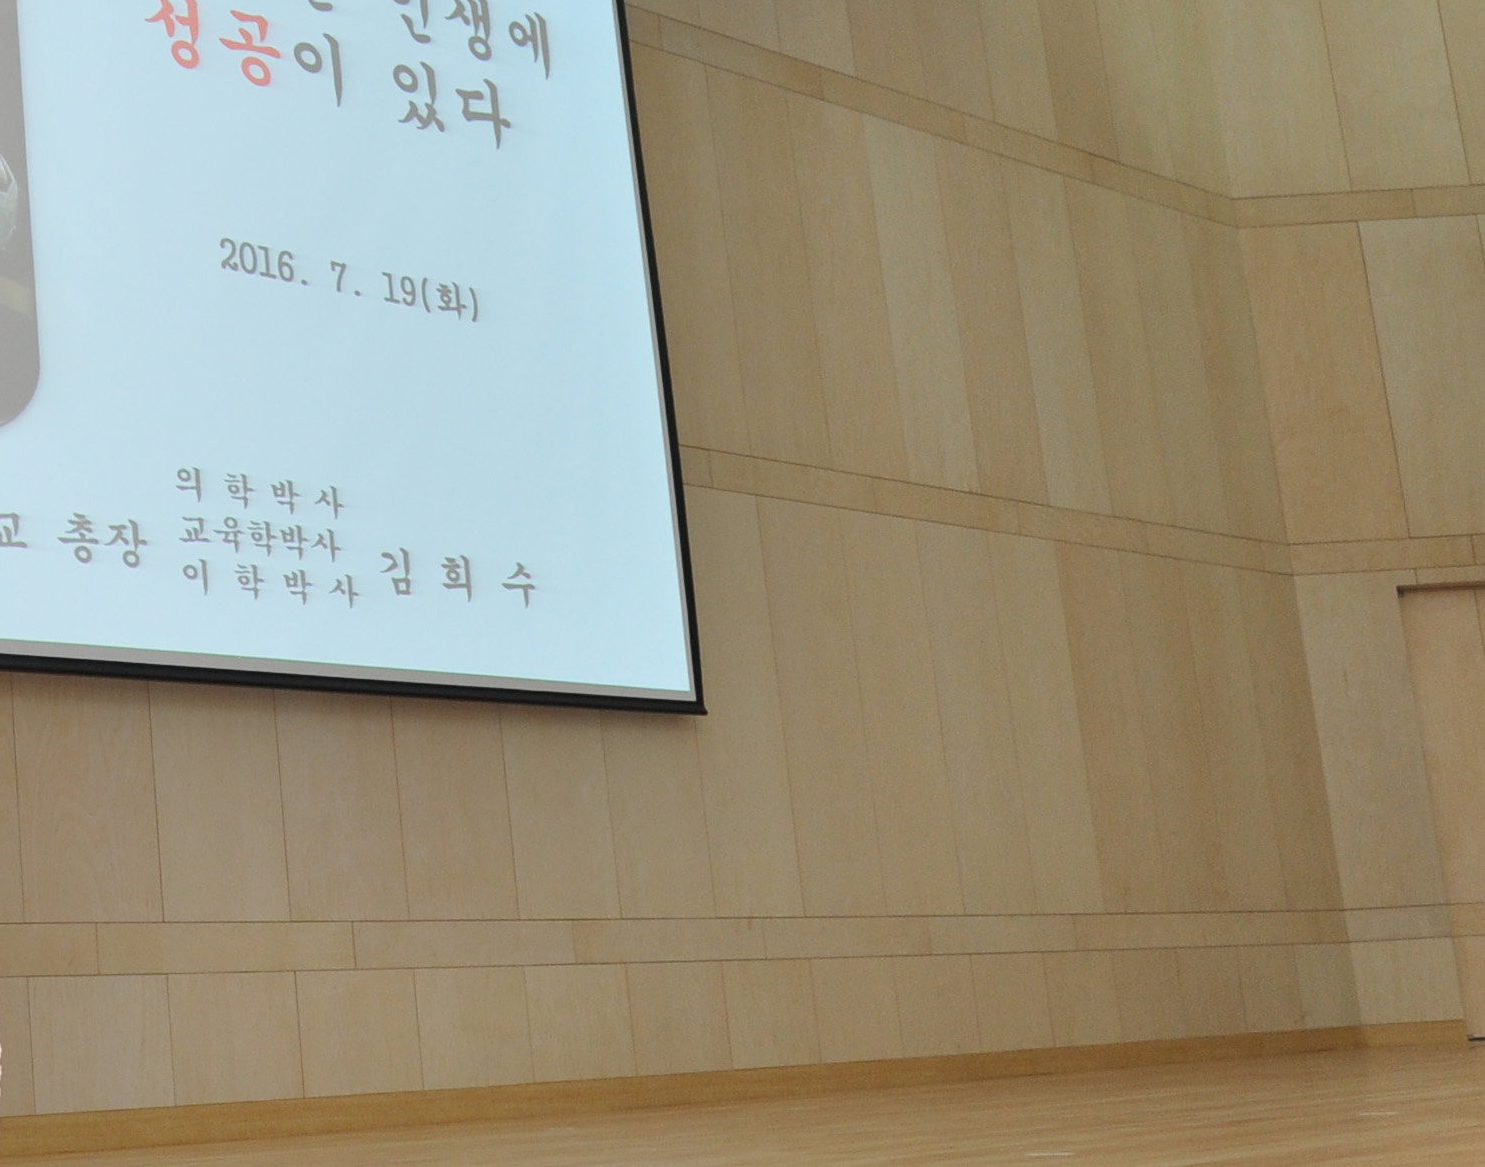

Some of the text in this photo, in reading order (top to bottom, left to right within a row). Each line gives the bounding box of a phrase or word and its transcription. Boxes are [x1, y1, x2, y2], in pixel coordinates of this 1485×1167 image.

[392, 61, 512, 150] 있다
[382, 271, 479, 323] 19(화)
[57, 511, 149, 570] 총장
[179, 515, 342, 564] 교육학박사
